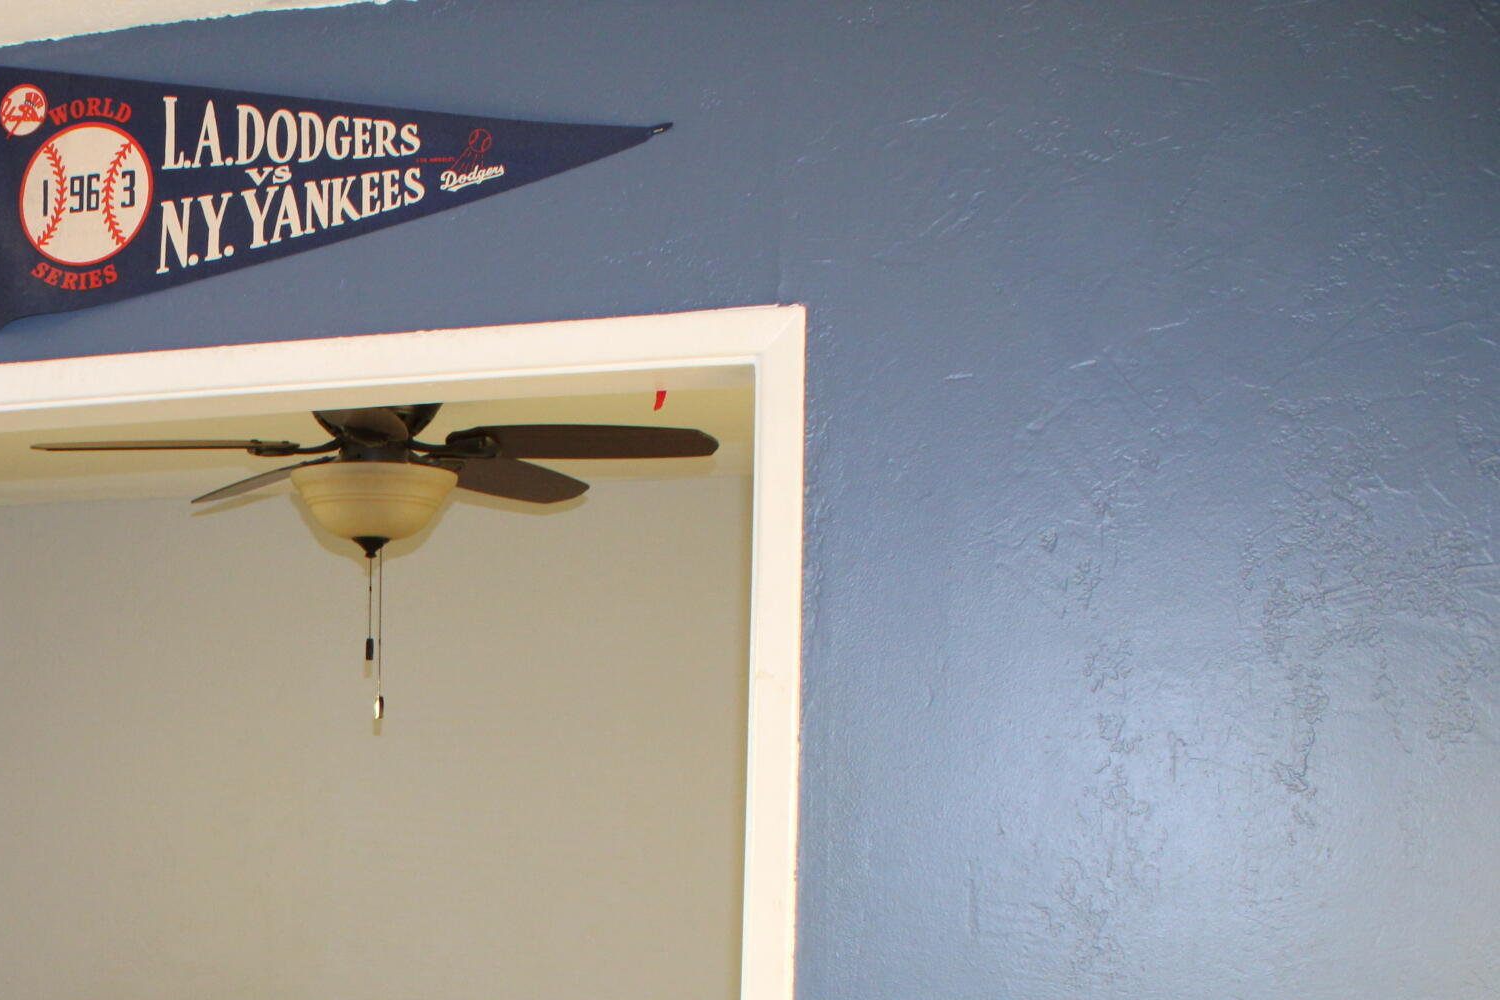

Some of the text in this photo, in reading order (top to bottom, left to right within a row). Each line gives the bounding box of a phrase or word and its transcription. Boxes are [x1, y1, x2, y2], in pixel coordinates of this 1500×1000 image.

[47, 97, 132, 126] WORLD
[161, 96, 421, 170] L.A. DODGERS
[440, 164, 505, 192] Dodgers
[156, 167, 426, 274] N.Y. YANKEES
[30, 262, 118, 291] SERIES
